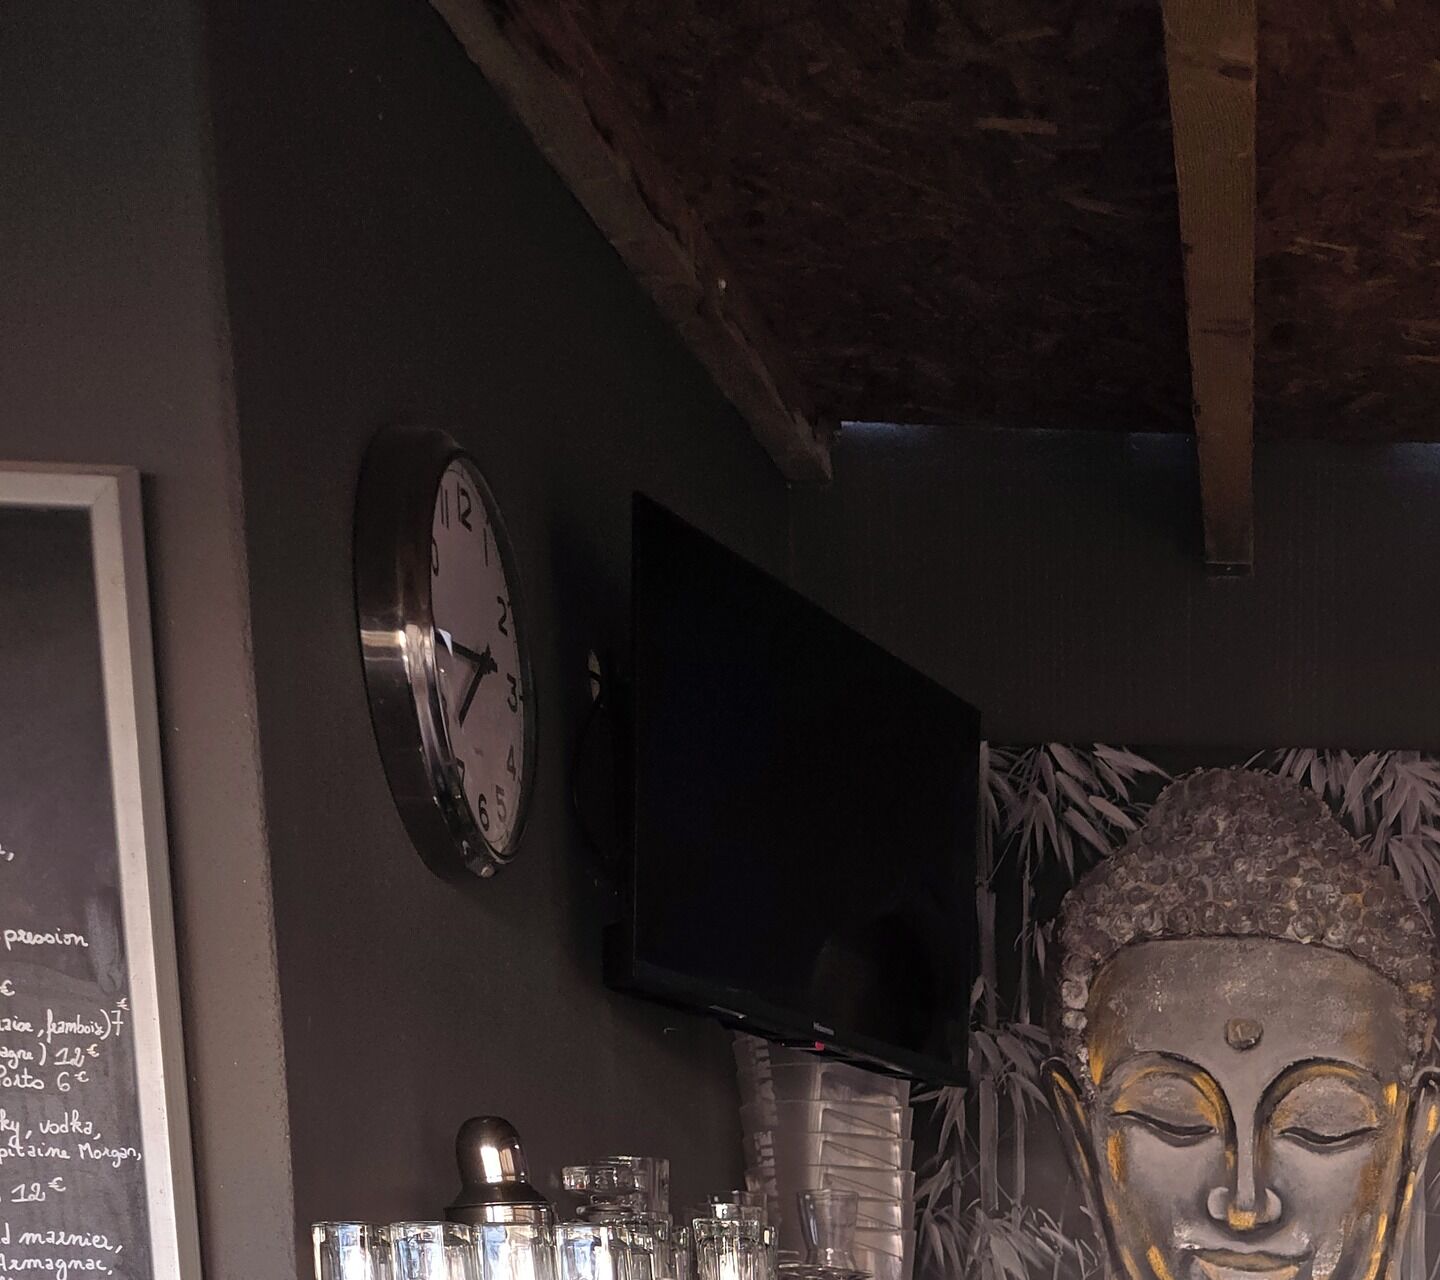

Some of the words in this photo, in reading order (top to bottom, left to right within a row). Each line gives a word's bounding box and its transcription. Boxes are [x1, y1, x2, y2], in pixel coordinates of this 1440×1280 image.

[496, 595, 509, 637] 2
[507, 672, 519, 714] 3
[506, 744, 517, 782] 4
[477, 792, 490, 832] 6
